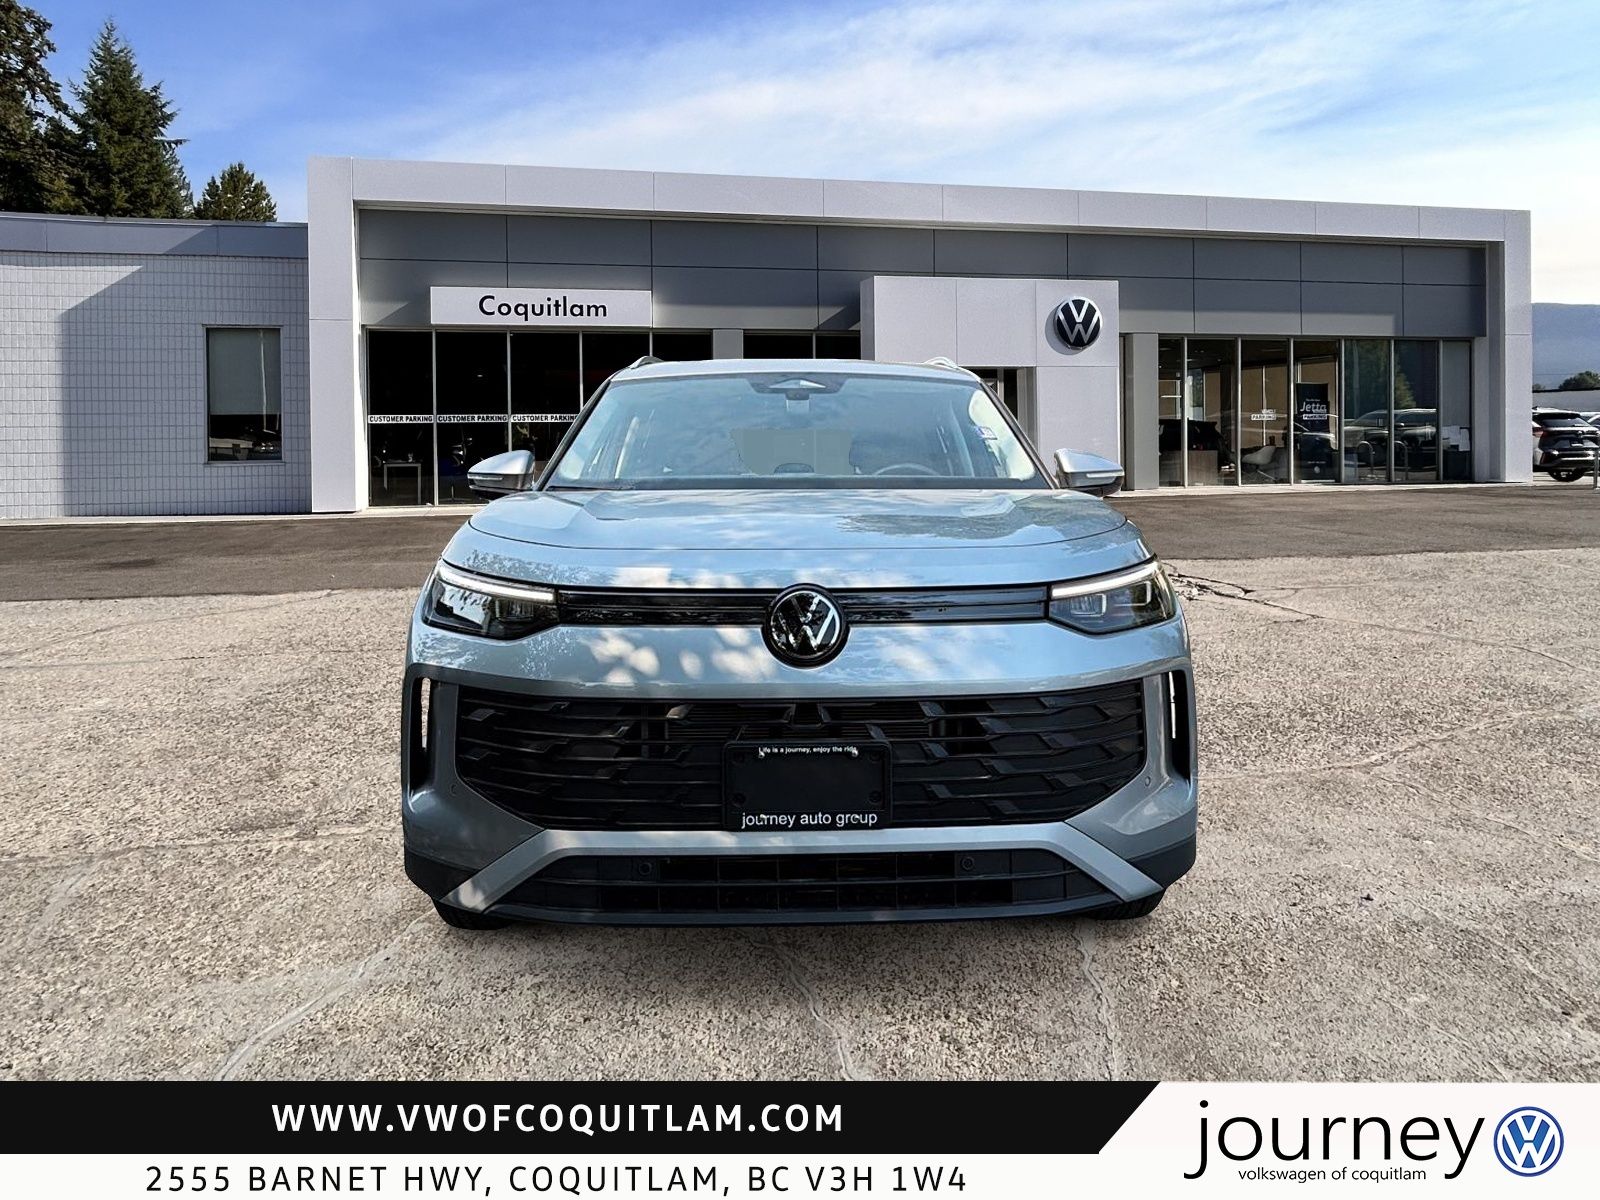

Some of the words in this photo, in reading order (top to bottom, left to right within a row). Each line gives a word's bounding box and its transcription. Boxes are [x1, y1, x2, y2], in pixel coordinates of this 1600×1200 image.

[478, 295, 607, 321] Coquitlam
[741, 812, 796, 829] journey
[800, 812, 831, 824] auto
[836, 813, 877, 827] group
